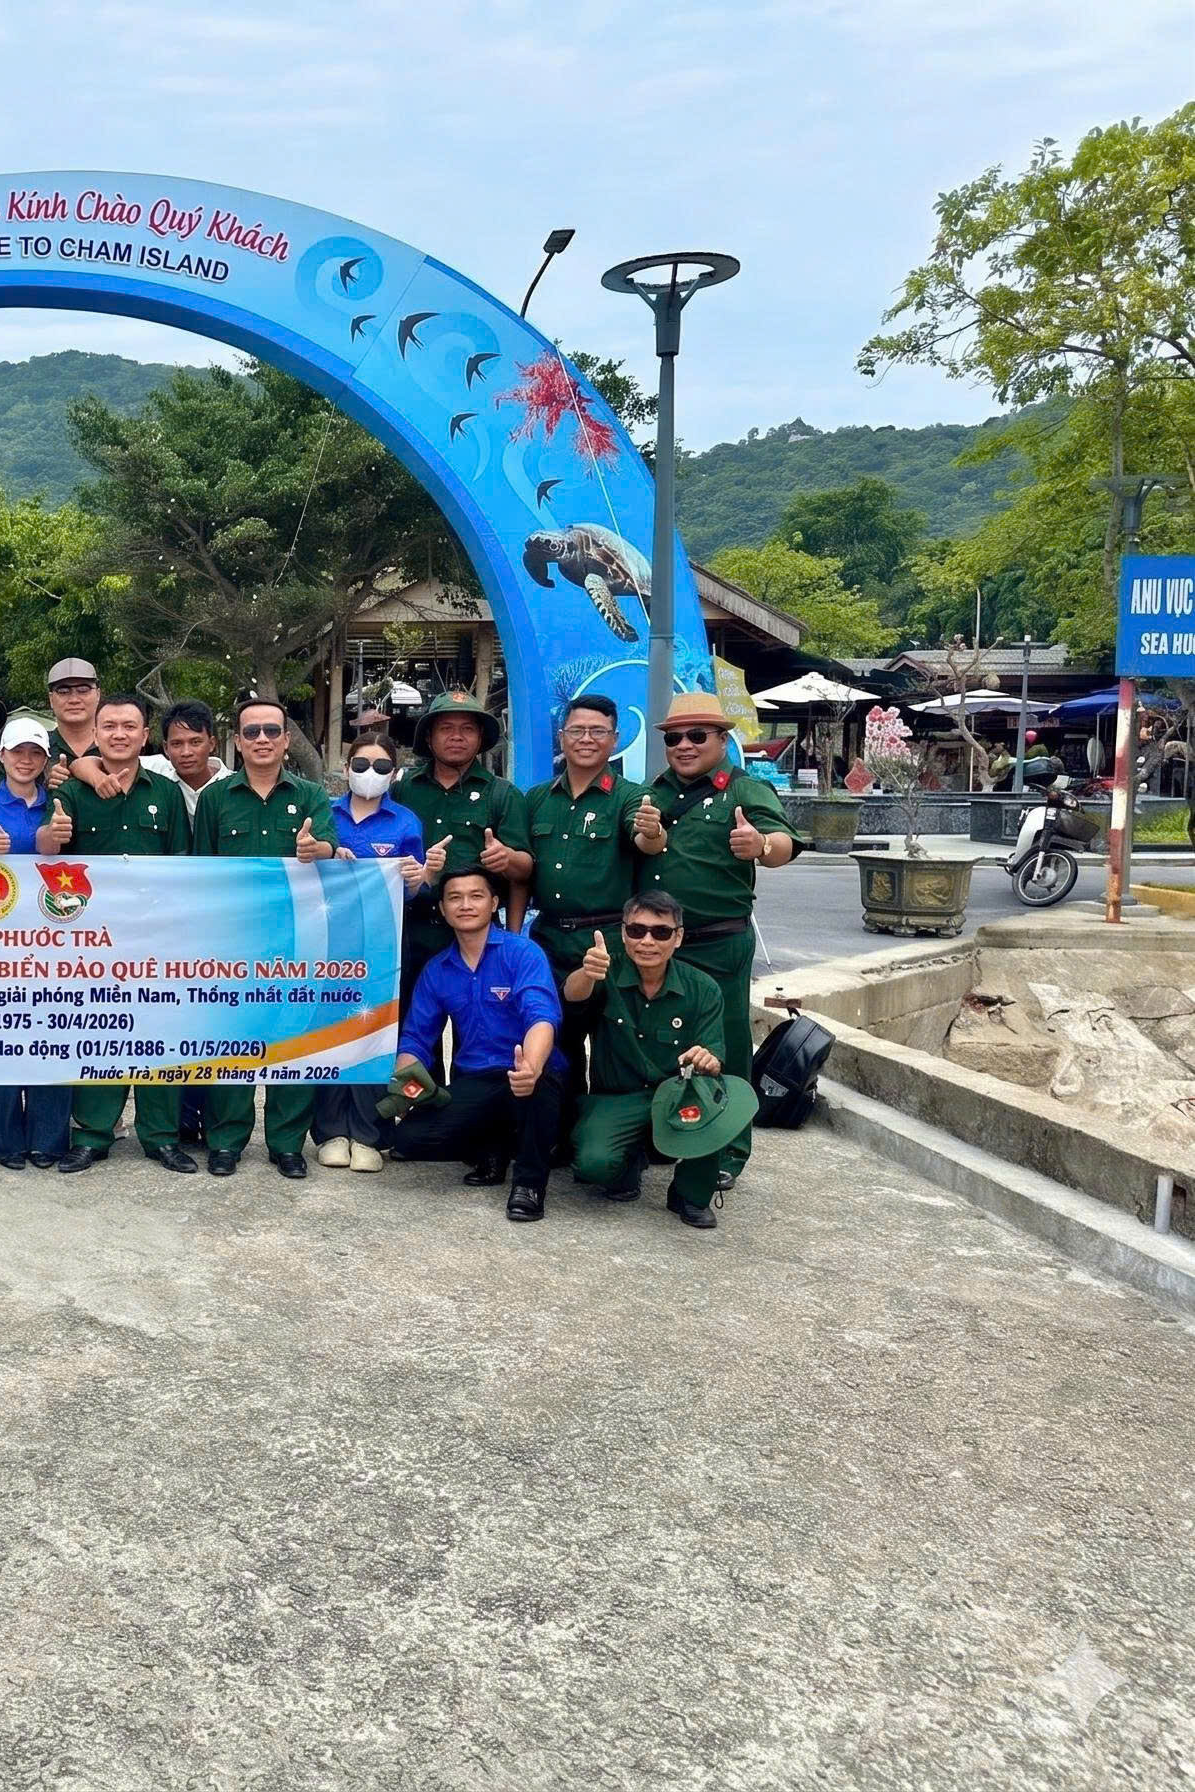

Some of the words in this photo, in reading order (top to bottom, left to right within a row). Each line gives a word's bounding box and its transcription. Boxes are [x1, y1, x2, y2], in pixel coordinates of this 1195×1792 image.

[7, 191, 68, 220] Kính
[76, 190, 141, 224] Chào
[149, 199, 203, 239] Quý
[207, 210, 289, 260] Khách
[18, 236, 52, 256] TO
[59, 238, 132, 263] CHAM
[139, 245, 229, 281] ISLAND
[1140, 632, 1168, 655] SEA
[1172, 632, 1195, 655] HU
[70, 926, 113, 947] TRÀ
[56, 955, 105, 978] ĐẢO
[111, 957, 158, 982] QUÊ
[165, 959, 248, 979] HƯƠNG
[314, 961, 367, 979] 2026
[32, 986, 84, 1007] phóng
[90, 984, 132, 1003] Miền
[138, 987, 181, 1005] Nam,
[187, 985, 239, 1007] Thống
[245, 985, 282, 1003] nhất
[288, 985, 315, 1003] đất
[47, 1013, 135, 1032] 30/4/2026)
[0, 1040, 24, 1056] lao
[29, 1040, 70, 1060] động
[76, 1040, 164, 1059] (01/5/1886
[180, 1040, 267, 1059] 01/5/2026)
[80, 1066, 124, 1080] Phước
[128, 1066, 154, 1082] Trà,
[158, 1067, 192, 1082] ngày
[195, 1067, 212, 1080] 28
[217, 1067, 255, 1082] tháng
[259, 1067, 268, 1080] 4
[271, 1067, 301, 1080] năm
[304, 1067, 340, 1080] 2026
